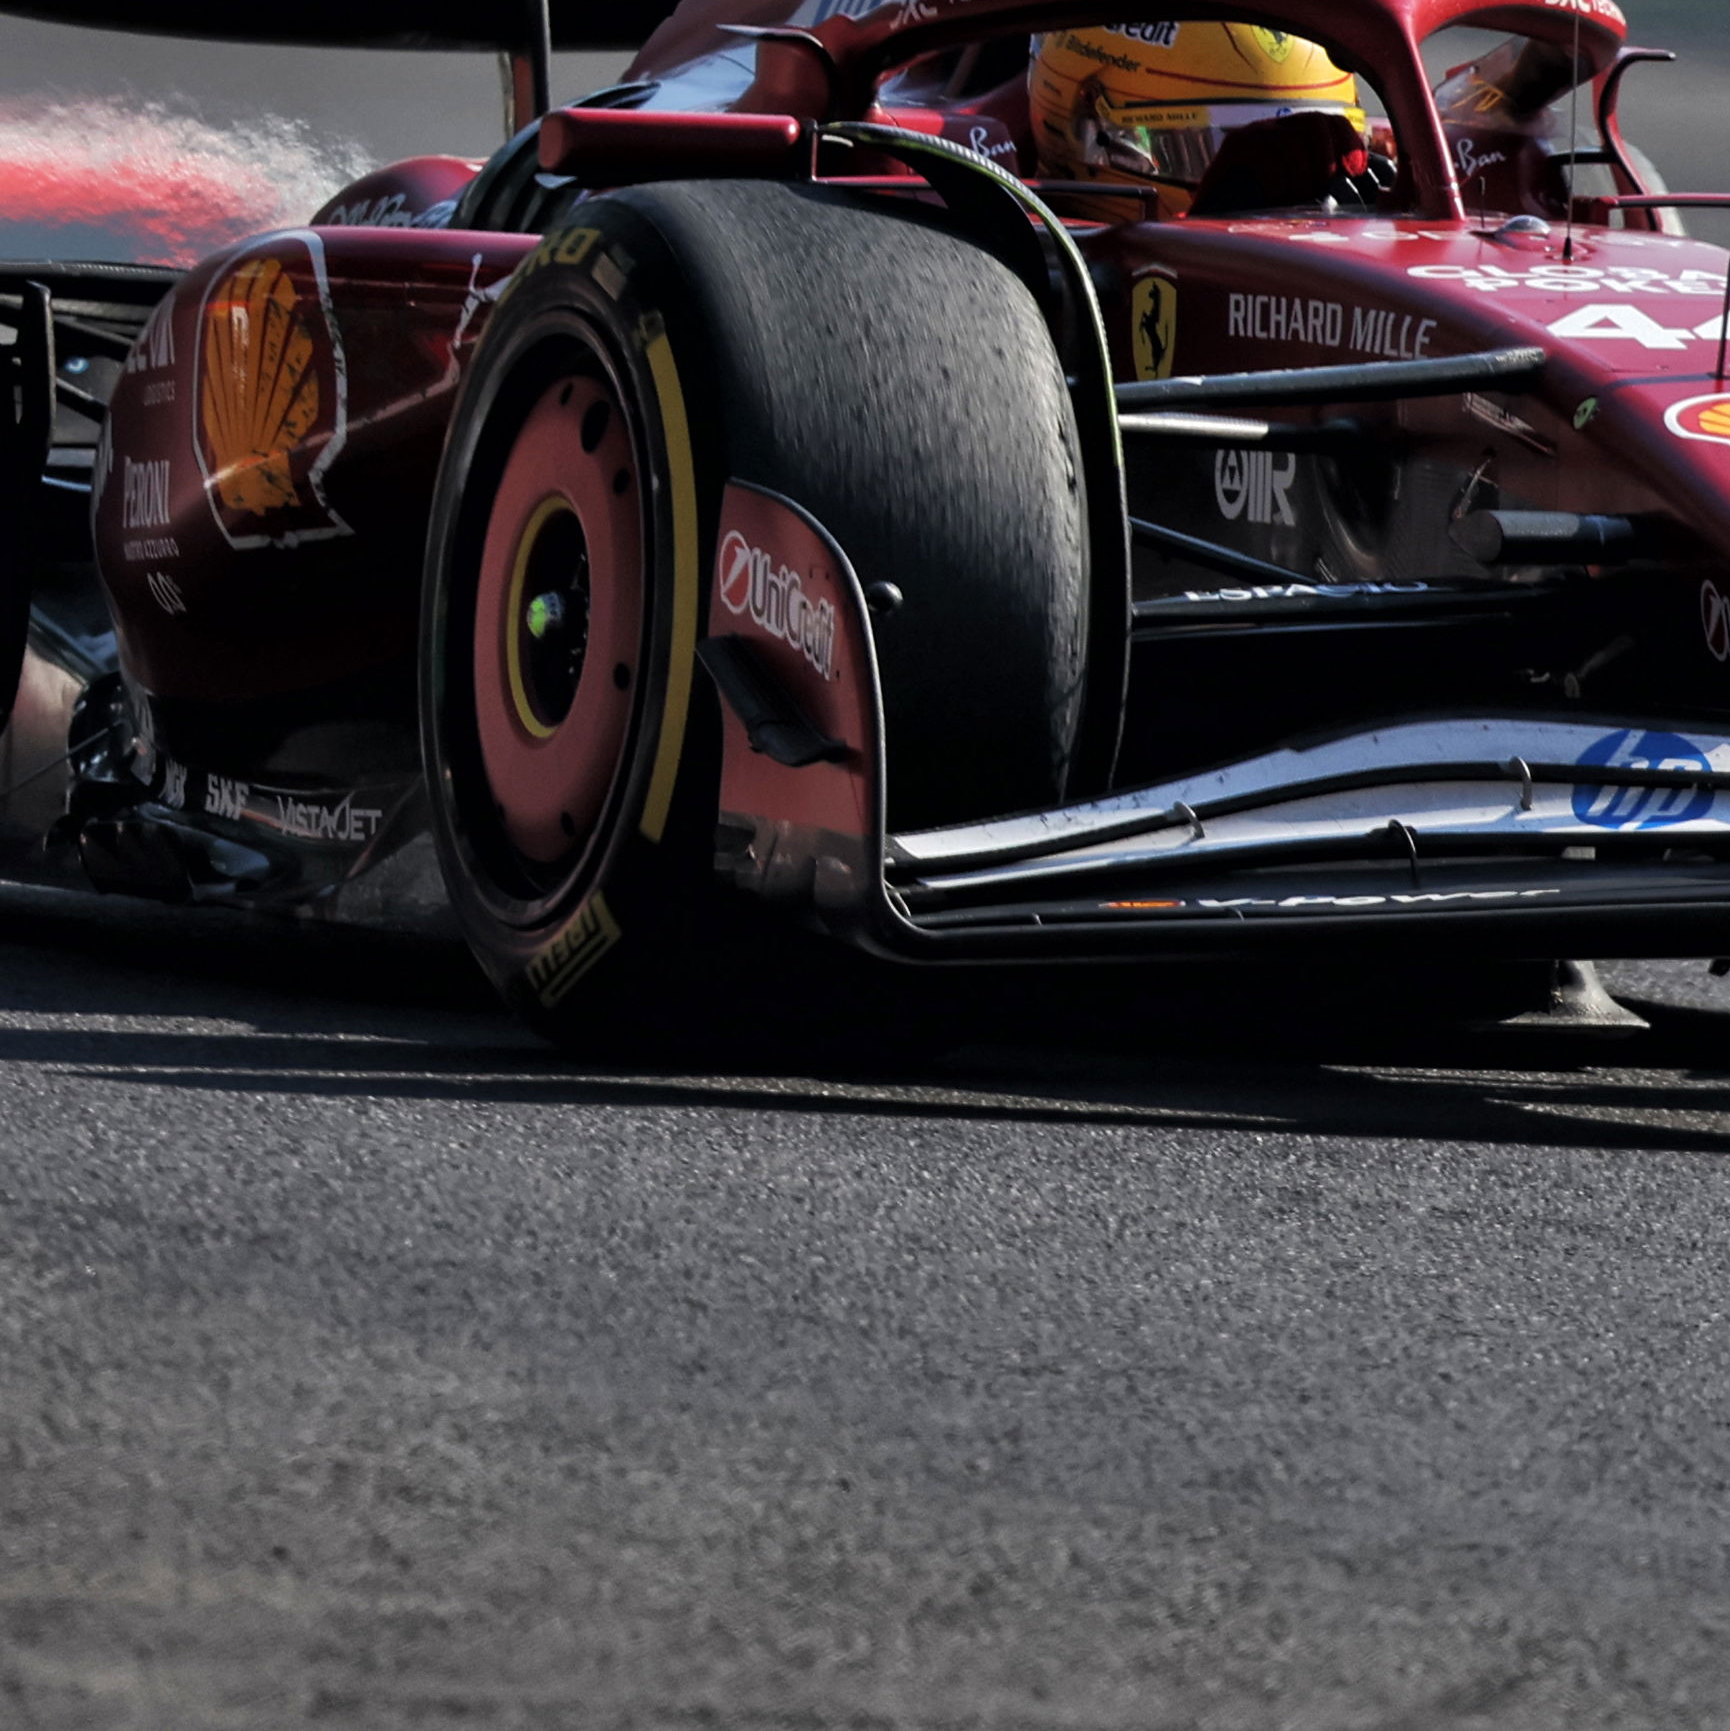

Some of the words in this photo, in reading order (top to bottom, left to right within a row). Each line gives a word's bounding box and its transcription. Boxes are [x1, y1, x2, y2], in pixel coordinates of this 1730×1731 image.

[1228, 293, 1344, 347] RICHARD
[1349, 305, 1438, 359] MILLE
[748, 547, 837, 682] UniCredit
[204, 773, 250, 821] SKF
[1585, 728, 1706, 831] hp
